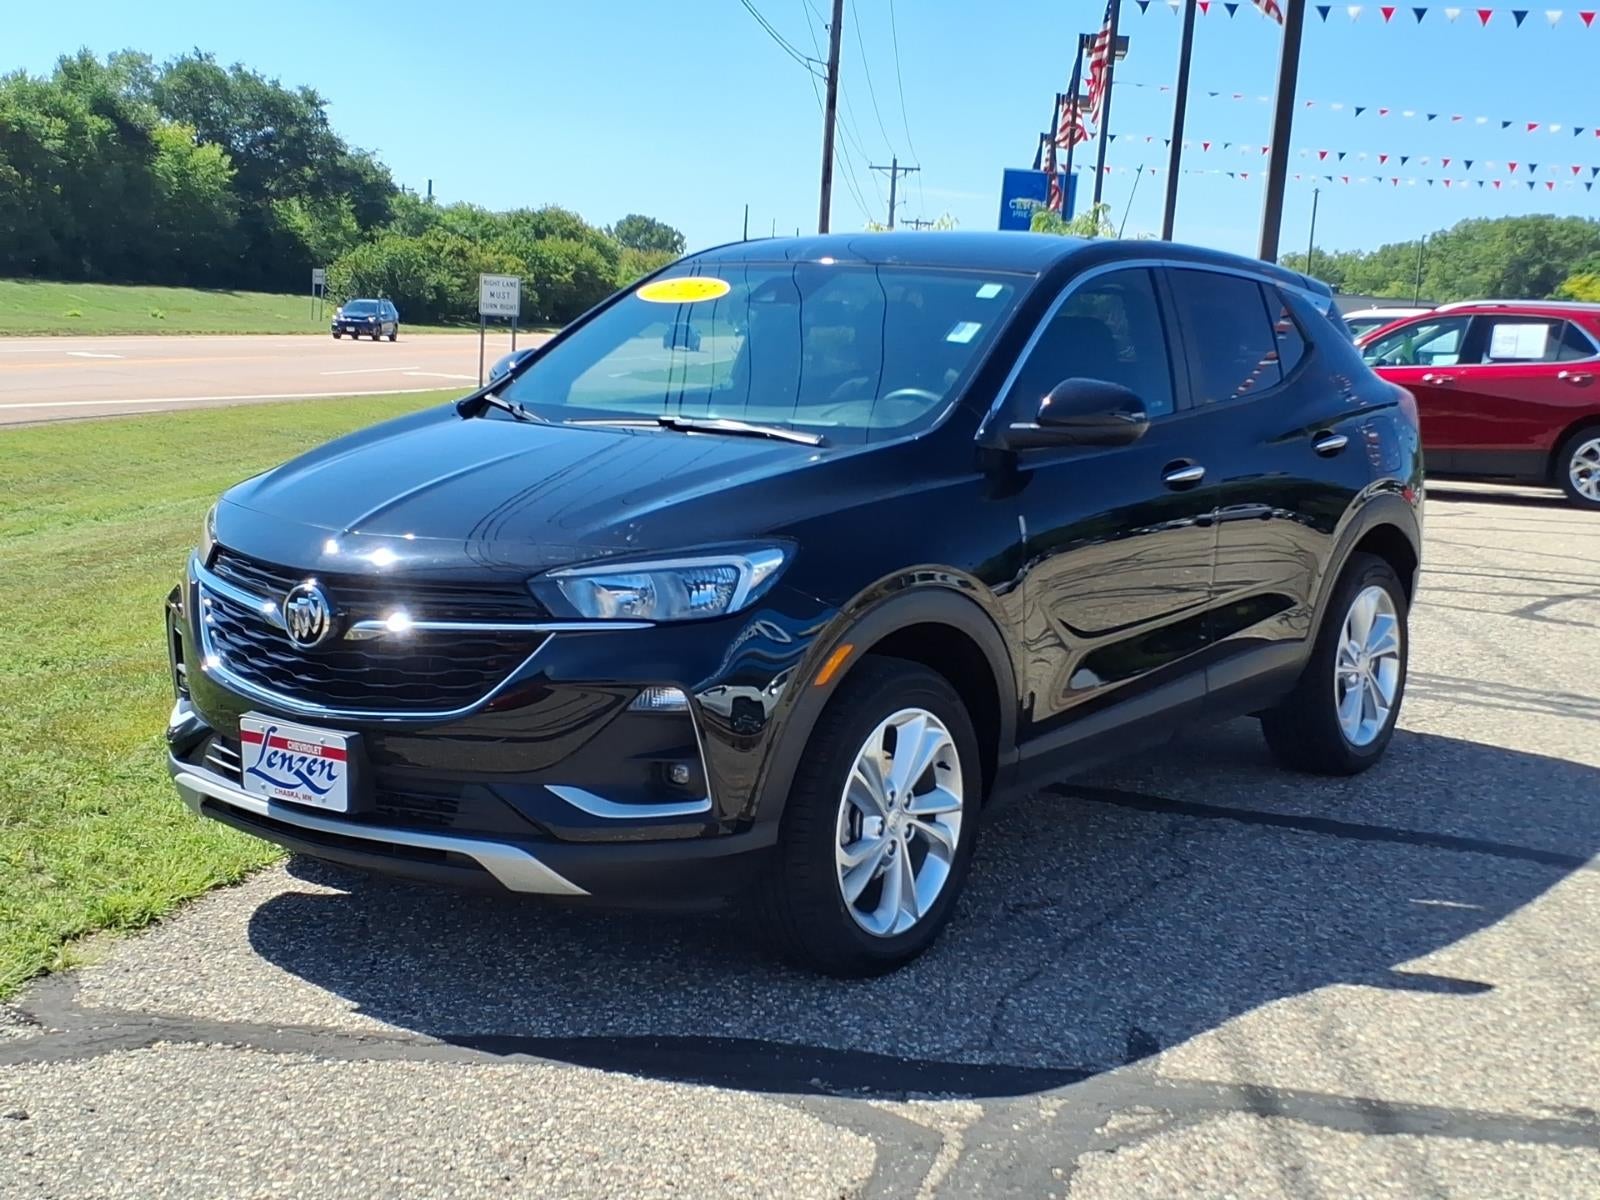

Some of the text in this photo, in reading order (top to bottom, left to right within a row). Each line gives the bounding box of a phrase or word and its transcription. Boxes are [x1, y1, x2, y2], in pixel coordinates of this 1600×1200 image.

[489, 291, 510, 300] MUST
[287, 740, 323, 755] CHEVROLET
[245, 725, 339, 795] Lenzen
[274, 787, 301, 799] CHASKA,
